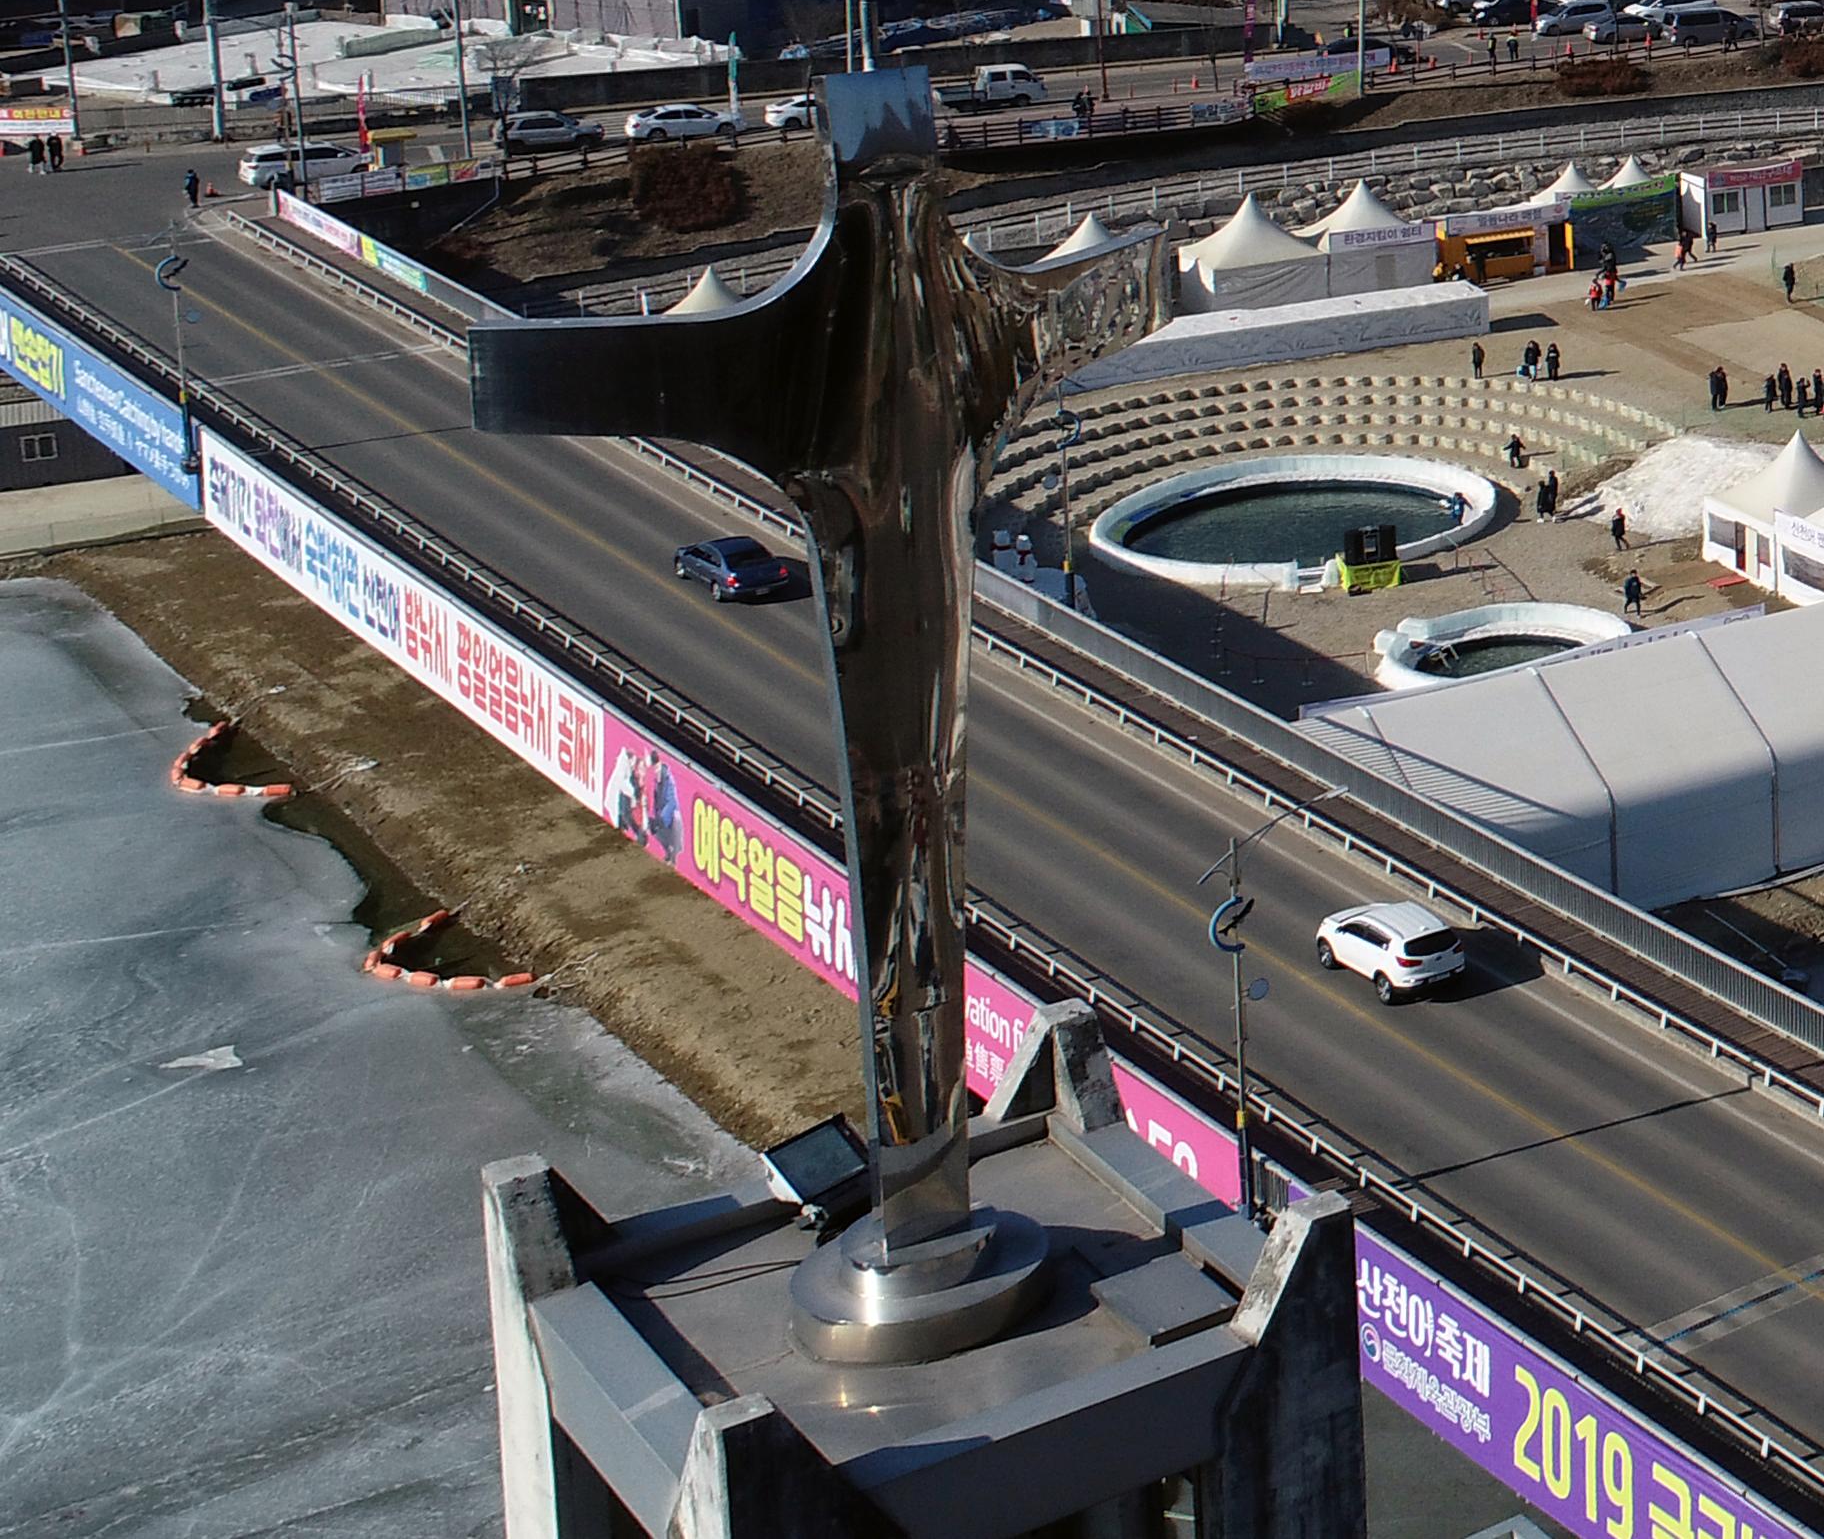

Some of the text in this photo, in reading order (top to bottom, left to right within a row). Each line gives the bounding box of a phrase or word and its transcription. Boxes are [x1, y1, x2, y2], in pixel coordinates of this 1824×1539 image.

[1344, 225, 1422, 245] 환경지킴이 쉼터
[305, 518, 361, 620] 숙박하면
[363, 565, 402, 648] 산천어
[455, 619, 553, 762] 평일얼음낚시
[558, 690, 597, 793] 공짜!
[1383, 1337, 1492, 1445] 문화체육관광부
[1513, 1364, 1634, 1539] 2019
